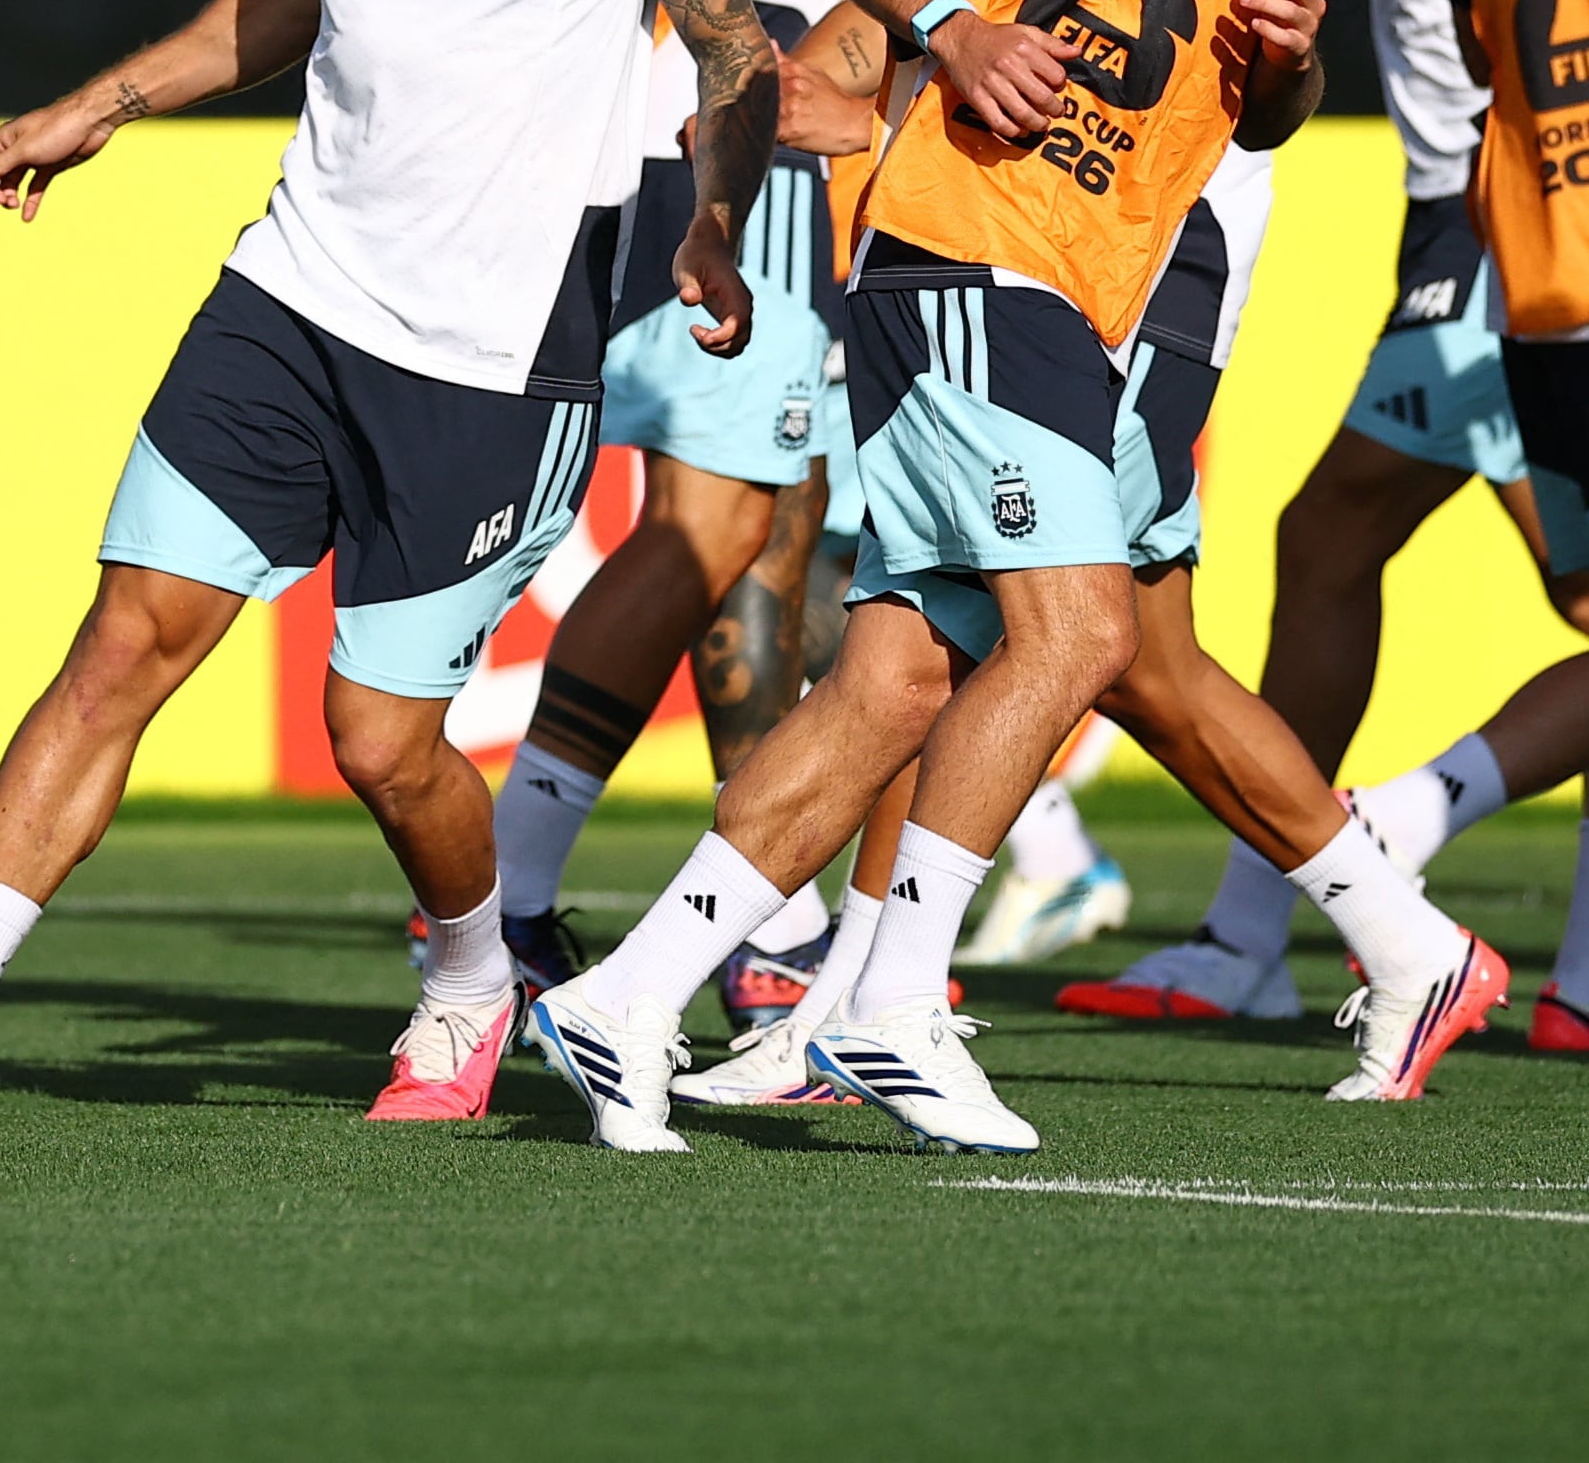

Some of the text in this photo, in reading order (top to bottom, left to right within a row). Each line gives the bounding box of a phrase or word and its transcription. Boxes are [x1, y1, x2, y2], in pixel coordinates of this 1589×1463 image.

[1050, 15, 1129, 81] FIFA
[1082, 111, 1136, 154] CUP
[464, 503, 515, 566] AFA
